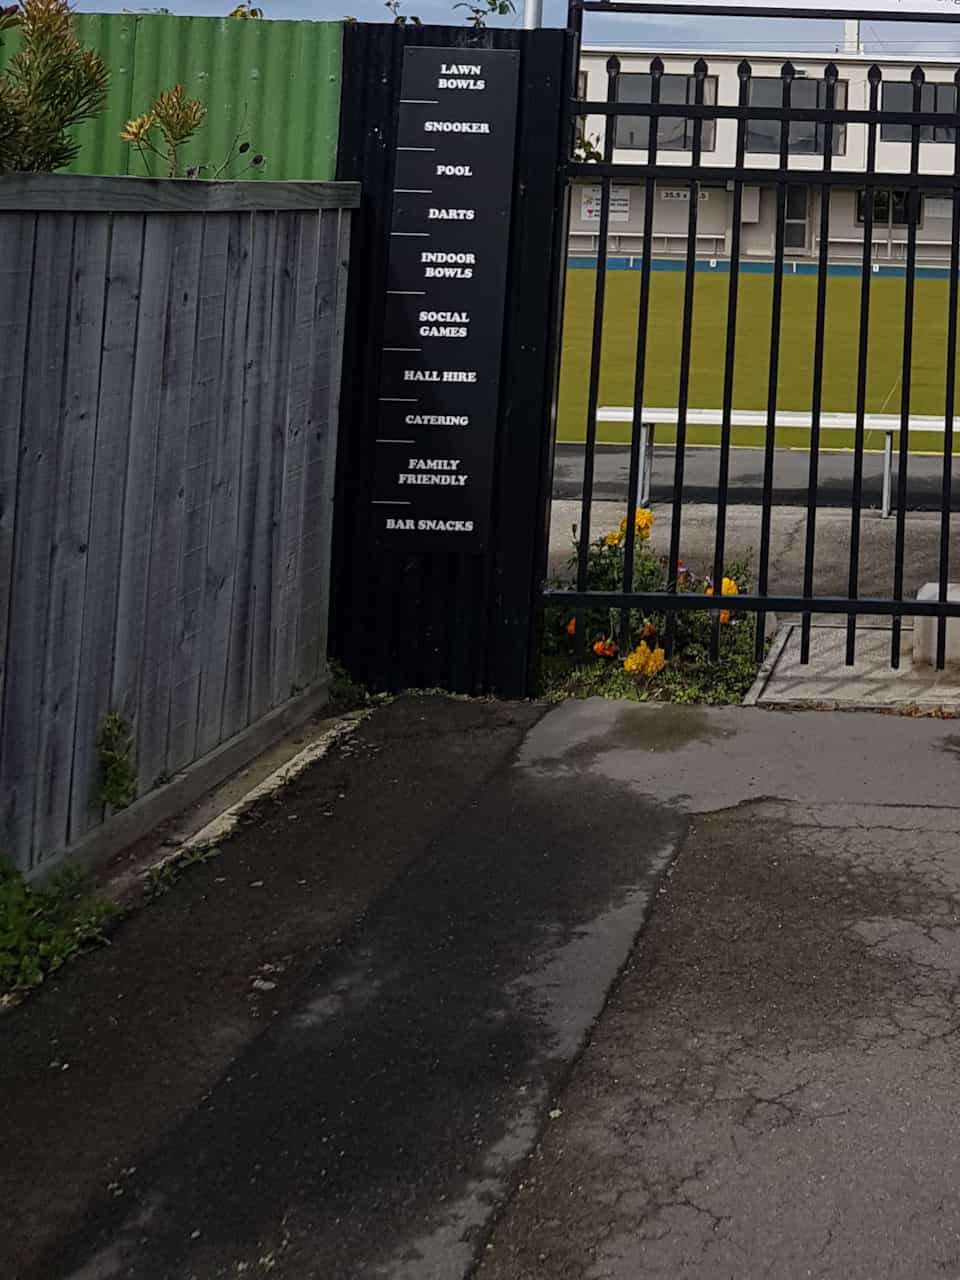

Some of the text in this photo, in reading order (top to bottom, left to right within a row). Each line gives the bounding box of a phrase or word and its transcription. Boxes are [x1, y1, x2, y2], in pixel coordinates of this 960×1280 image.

[440, 63, 482, 75] LAWN
[438, 78, 485, 90] BOWLS
[424, 121, 490, 134] SNOOKER
[436, 164, 473, 177] POOL
[427, 208, 475, 220] DARTS
[420, 252, 476, 265] INDOOR
[424, 267, 473, 279] BOWLS
[418, 311, 470, 323] SOCIAL
[419, 325, 468, 338] GAMES
[403, 370, 477, 383] HALL HIRE
[405, 414, 469, 426] CATERING
[408, 458, 461, 471] FAMILY
[398, 473, 469, 486] FRIENDLY
[385, 518, 474, 532] BAR SNACKS
